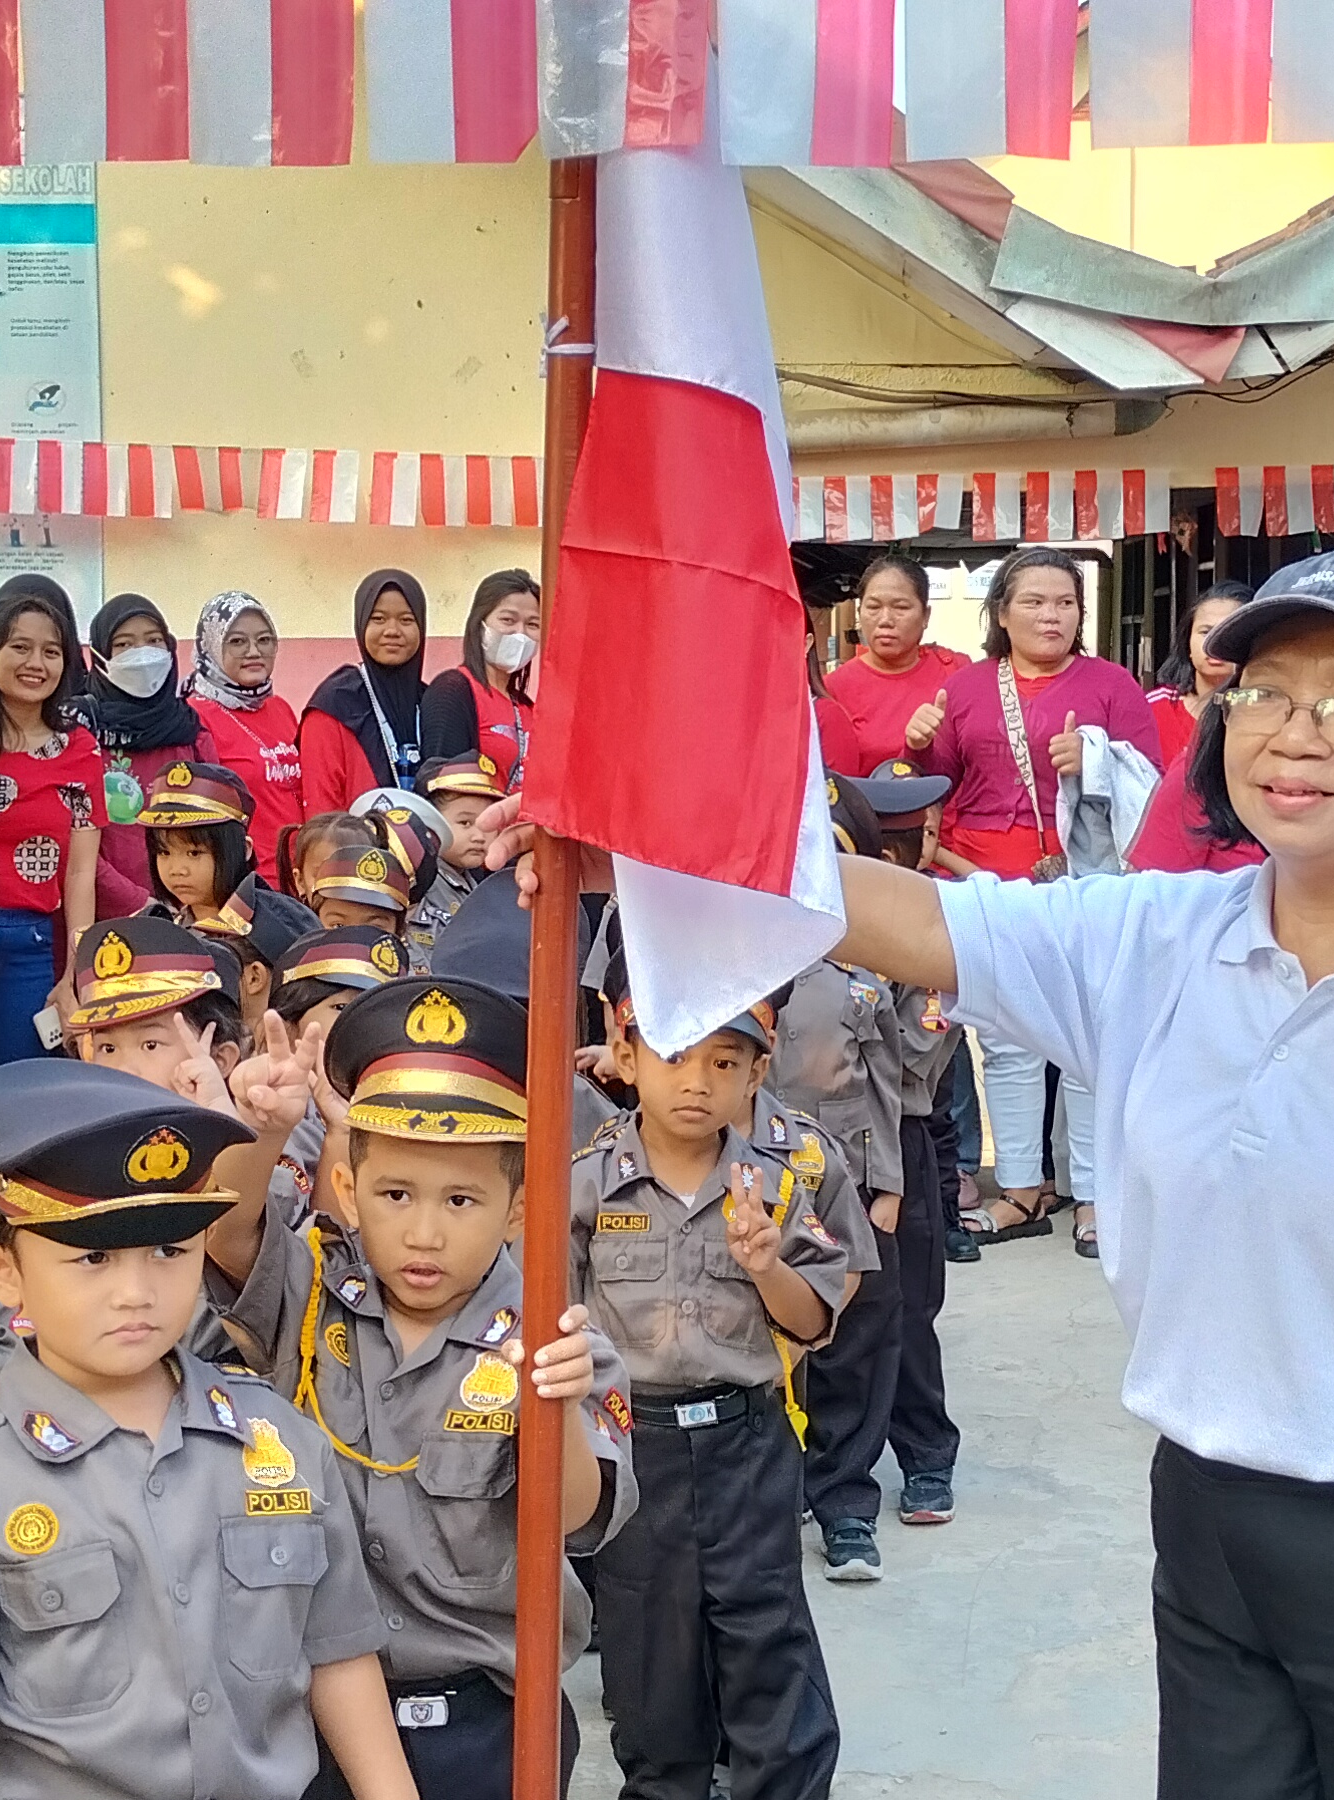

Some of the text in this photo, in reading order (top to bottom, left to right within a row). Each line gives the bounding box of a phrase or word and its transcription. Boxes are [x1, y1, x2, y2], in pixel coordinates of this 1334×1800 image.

[0, 165, 92, 195] SEKOLAH
[602, 1217, 647, 1230] POLISI
[608, 1392, 630, 1430] POLRI
[449, 1413, 509, 1431] POLISI
[248, 1492, 308, 1512] POLISI
